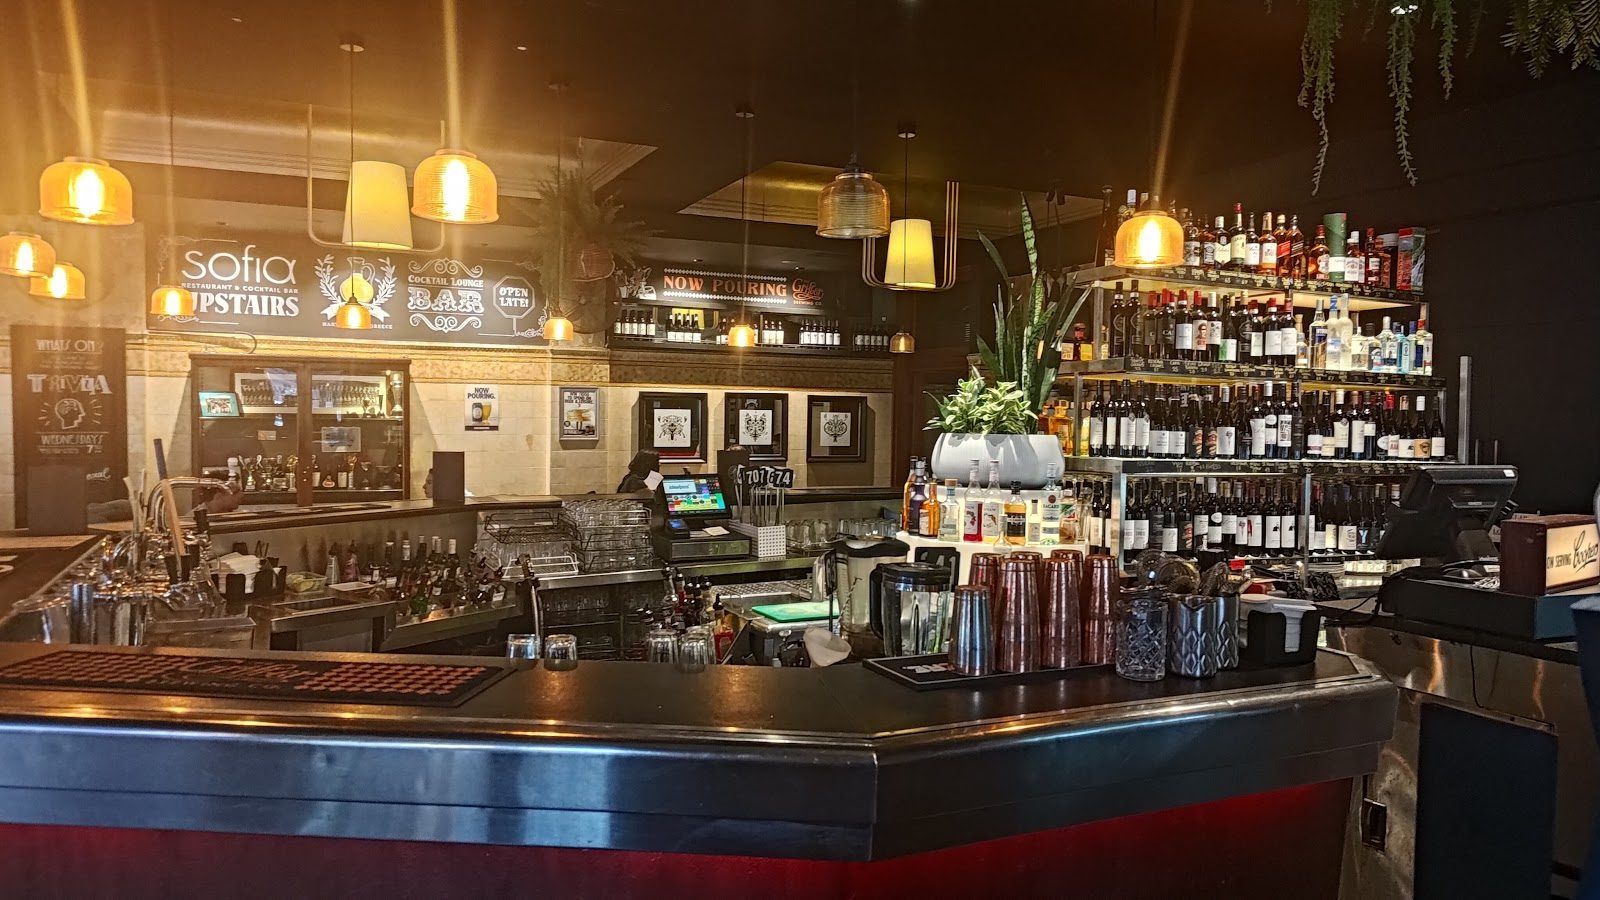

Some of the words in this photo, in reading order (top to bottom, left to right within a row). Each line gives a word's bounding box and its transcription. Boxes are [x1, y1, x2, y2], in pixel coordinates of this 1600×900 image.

[182, 245, 297, 285] sofia
[182, 282, 233, 291] RESTAURANT
[408, 275, 449, 286] COCKTAIL
[451, 278, 484, 288] LOUNGE
[663, 275, 704, 291] NOW
[712, 279, 787, 297] POURING
[499, 287, 529, 297] OPEN
[407, 286, 485, 313] BAR
[499, 297, 529, 308] LATE!
